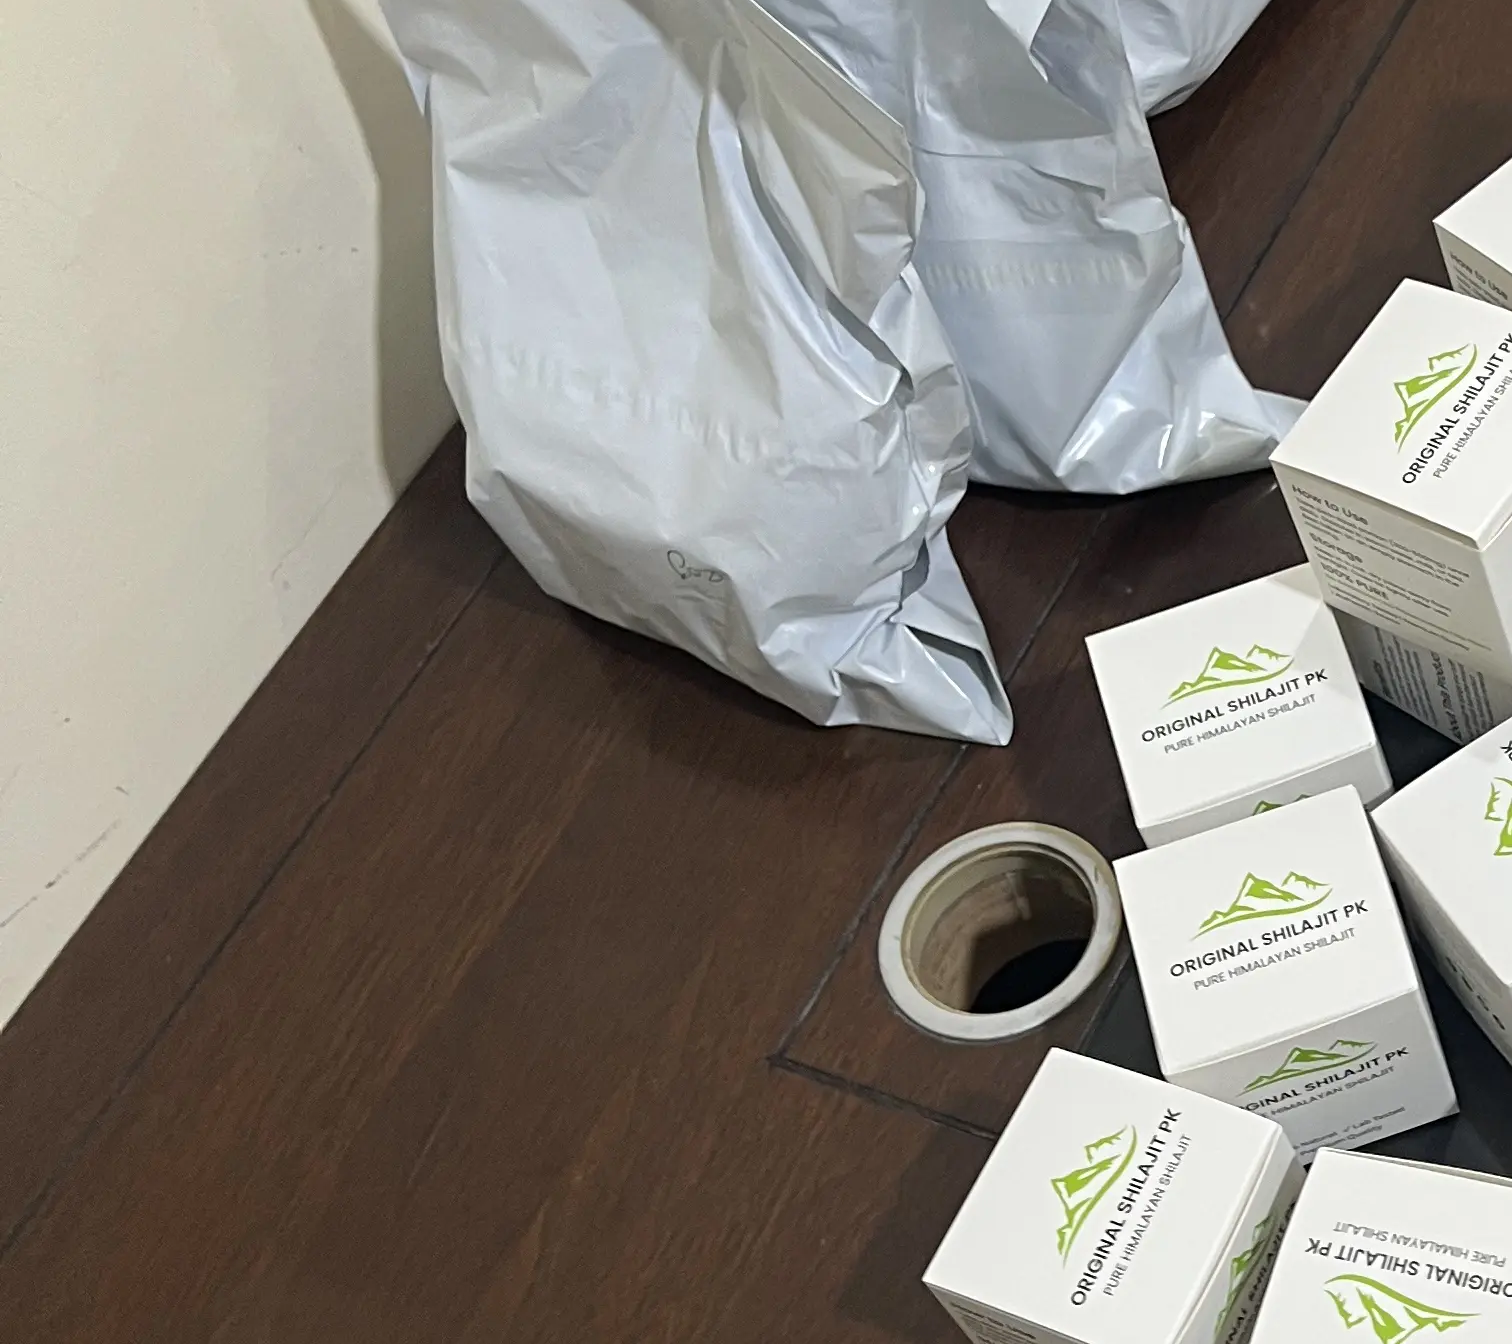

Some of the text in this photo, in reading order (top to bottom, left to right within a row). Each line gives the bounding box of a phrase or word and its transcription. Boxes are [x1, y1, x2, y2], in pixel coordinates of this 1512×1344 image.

[1402, 418, 1459, 483] ORIGINAL
[1453, 353, 1502, 413] SHILAJIT
[1433, 452, 1456, 478] PURE
[1452, 395, 1498, 451] HIMALAYAN
[1141, 668, 1327, 741] ORIGINAL SHILAJIT PK
[1164, 693, 1314, 753] PURE HIMALAYAN SHILAJIT
[1170, 900, 1367, 976] ORIGINAL SHILAJIT PK
[1193, 927, 1354, 989] PURE HIMALAYAN SHILAJIT
[1304, 1047, 1408, 1091] SHILAJIT PK
[1071, 1108, 1180, 1305] ORIGINAL SHILAJIT PK
[1103, 1135, 1190, 1295] PURE HIMALAYAN SHILAJIT
[1305, 1238, 1331, 1256] PK
[1334, 1245, 1419, 1275] SHILAJIT
